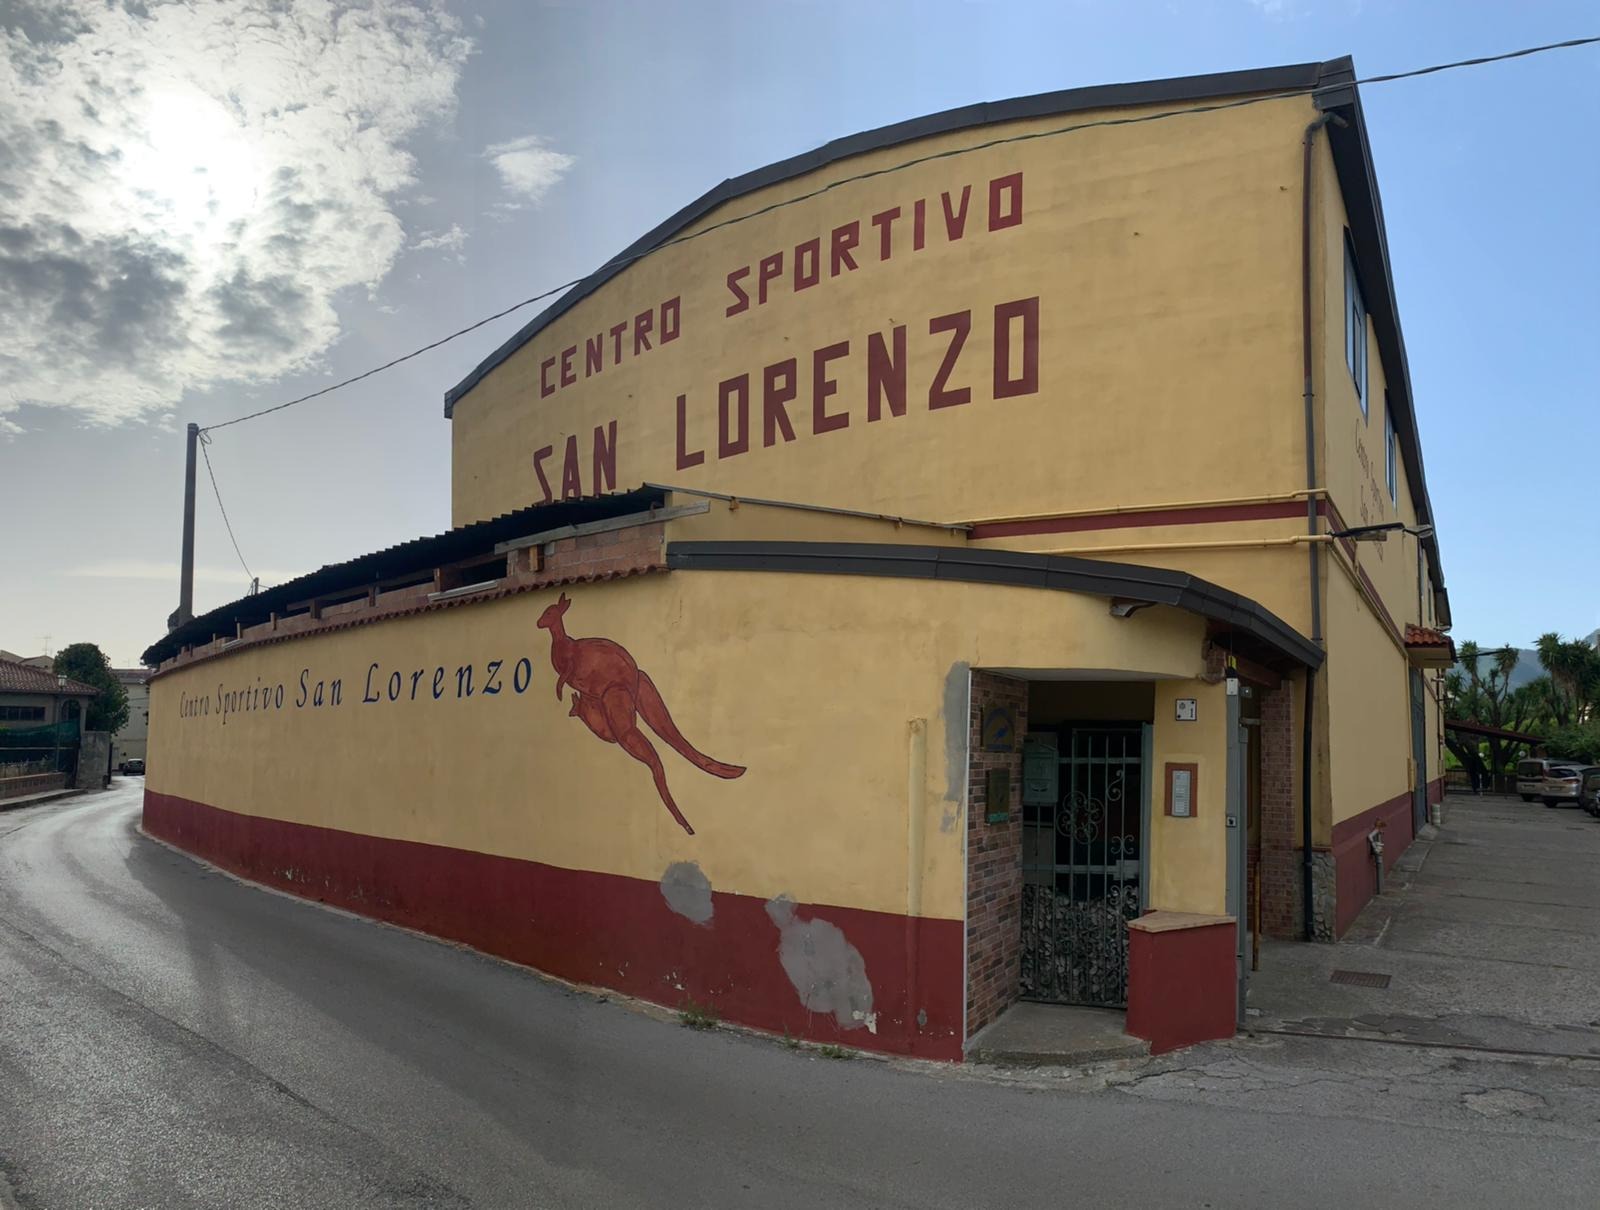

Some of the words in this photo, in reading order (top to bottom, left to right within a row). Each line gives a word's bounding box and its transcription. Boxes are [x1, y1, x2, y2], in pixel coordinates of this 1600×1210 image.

[541, 296, 680, 398] CENTRO
[726, 172, 1022, 317] SPORTIVO
[533, 420, 617, 502] SAN
[677, 296, 1039, 471] LORENZO
[180, 690, 210, 718] Centro
[215, 677, 284, 725] Sportivo
[296, 669, 342, 708] San
[363, 657, 531, 703] Lorenzo
